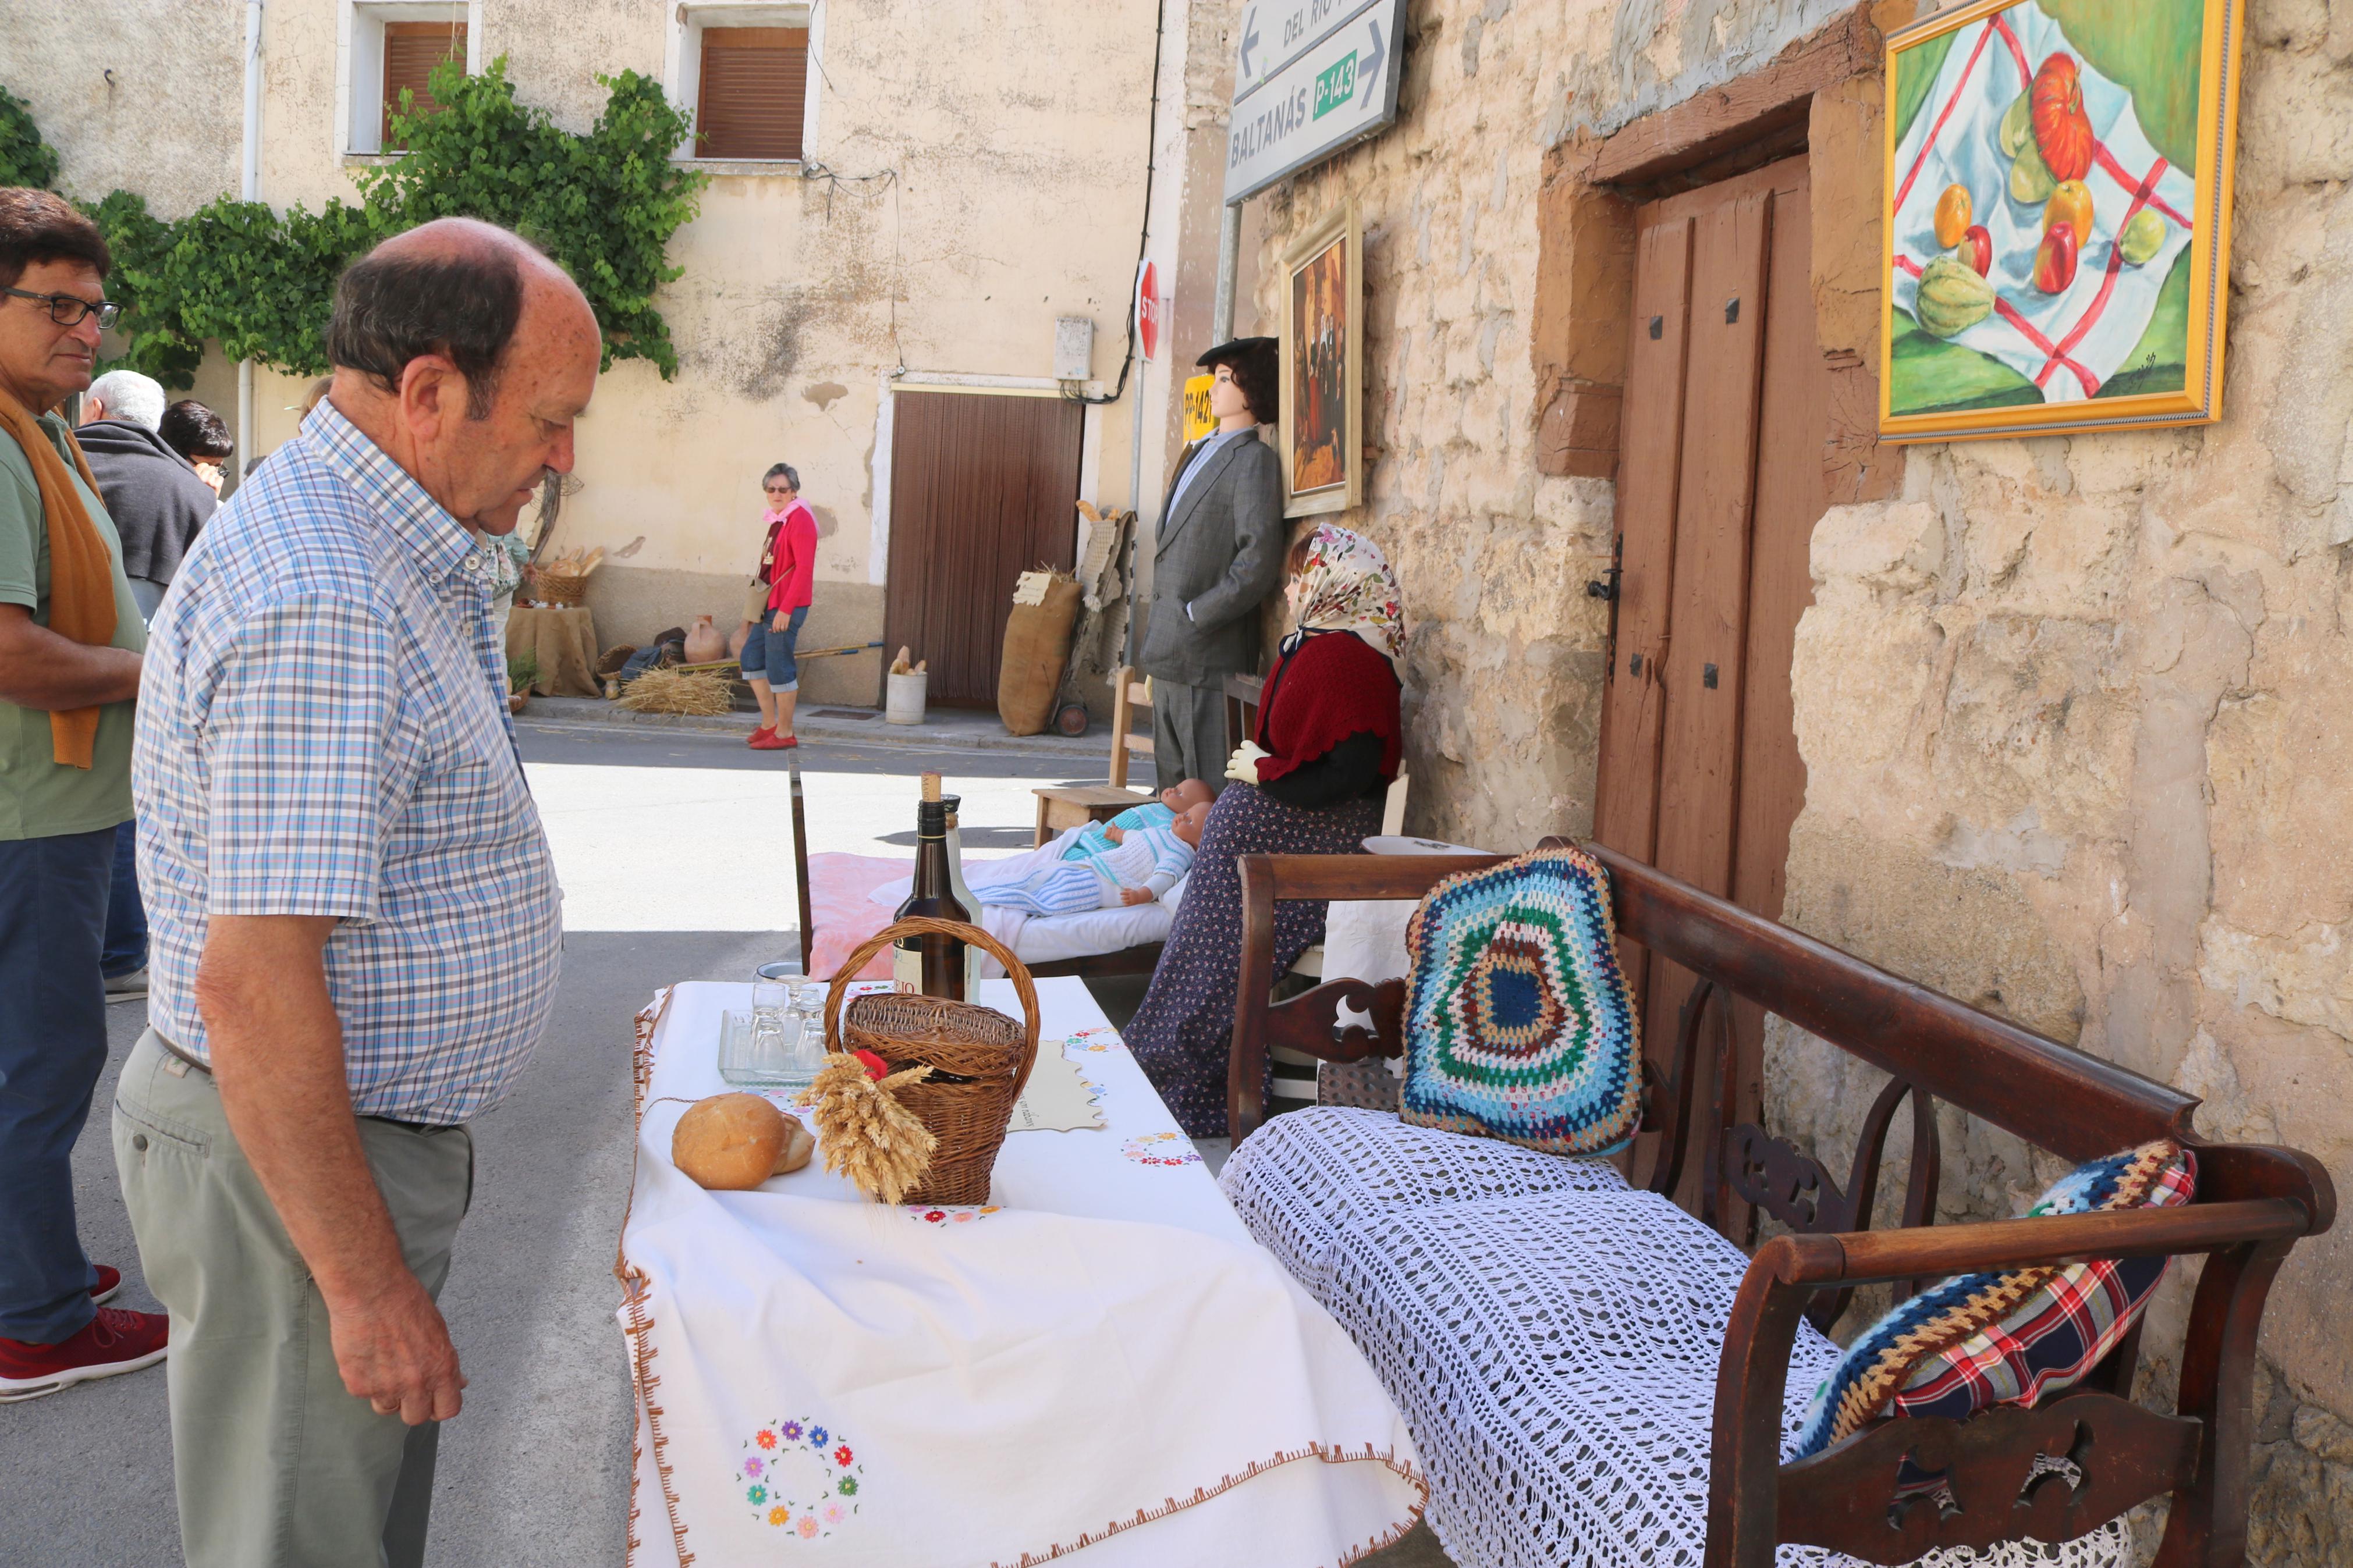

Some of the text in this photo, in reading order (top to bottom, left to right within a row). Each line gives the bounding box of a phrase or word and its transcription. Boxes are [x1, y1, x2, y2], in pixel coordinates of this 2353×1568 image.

[1283, 8, 1304, 48] DEL
[1231, 59, 1354, 169] BALTANÁS P-143
[1142, 296, 1158, 326] STOP
